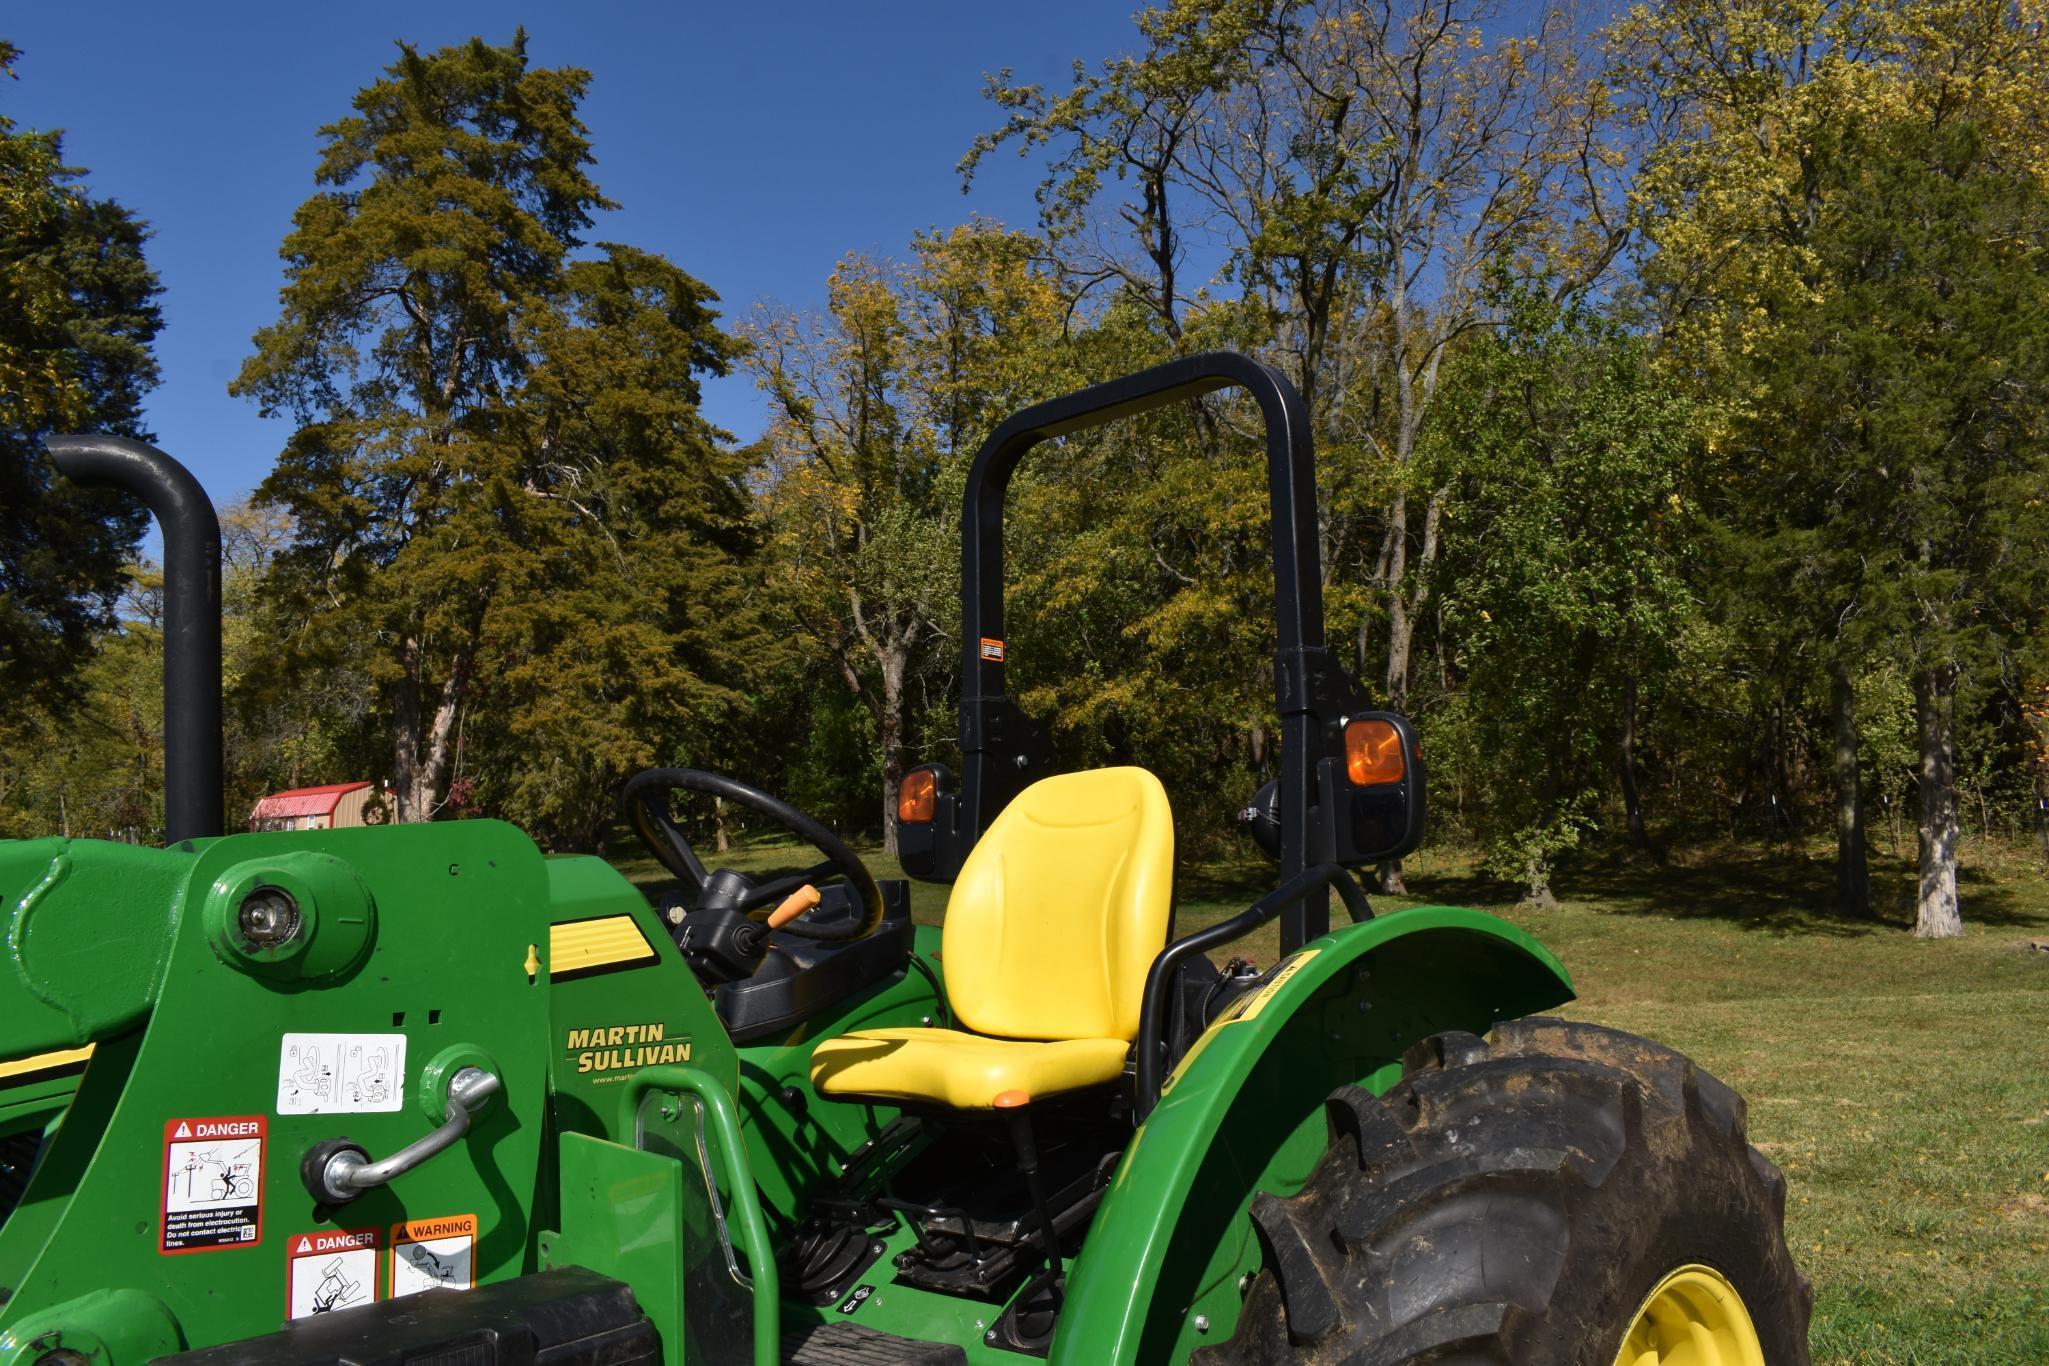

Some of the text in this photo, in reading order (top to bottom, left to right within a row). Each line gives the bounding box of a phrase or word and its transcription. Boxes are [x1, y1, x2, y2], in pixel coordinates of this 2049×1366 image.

[567, 1023, 664, 1050] MARTIN
[578, 1043, 691, 1073] SULLIVAN
[196, 1122, 258, 1137] DANGER
[189, 1212, 214, 1220] serious
[215, 1210, 234, 1218] injury
[167, 1222, 186, 1230] death
[205, 1217, 250, 1227] electrocution.
[413, 1220, 472, 1238] WARNING
[167, 1231, 176, 1239] Do
[191, 1228, 216, 1236] contact
[217, 1226, 241, 1234] electric
[317, 1232, 374, 1251] DANGER
